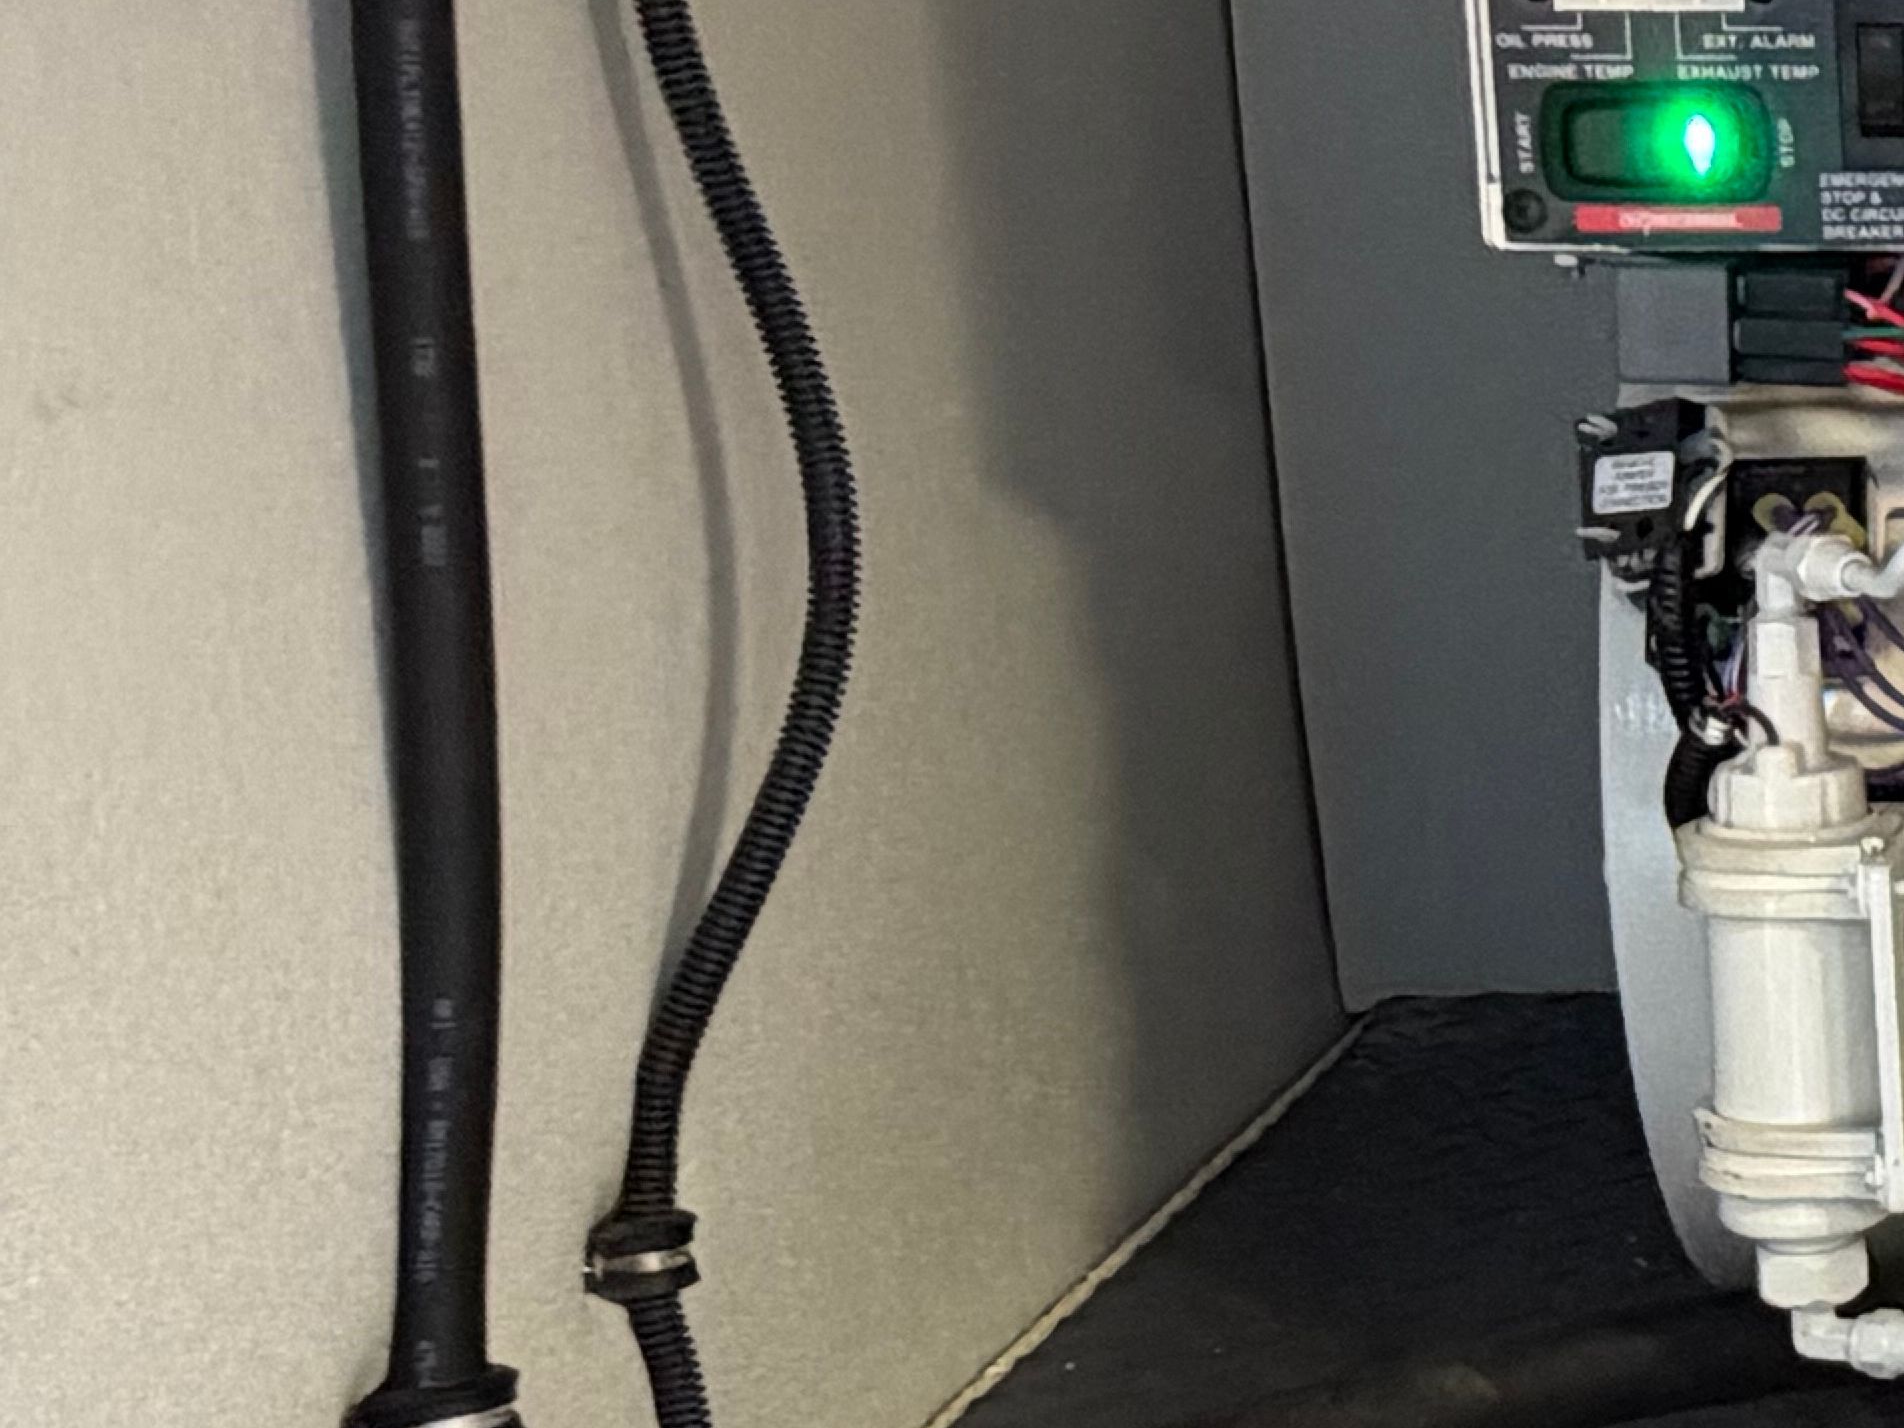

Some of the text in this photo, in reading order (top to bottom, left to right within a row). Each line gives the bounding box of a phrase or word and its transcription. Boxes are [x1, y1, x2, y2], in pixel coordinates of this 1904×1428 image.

[1495, 33, 1594, 49] OIL PRESS
[1750, 33, 1816, 49] ALARM
[1507, 63, 1635, 80] ENGINE TEMP
[1677, 64, 1821, 80] EXHAUST TEMP
[1514, 110, 1535, 174] START
[1777, 117, 1796, 168] STOP
[1821, 191, 1866, 205] STOP
[1822, 207, 1845, 222] DC
[1823, 224, 1904, 240] BREAKER
